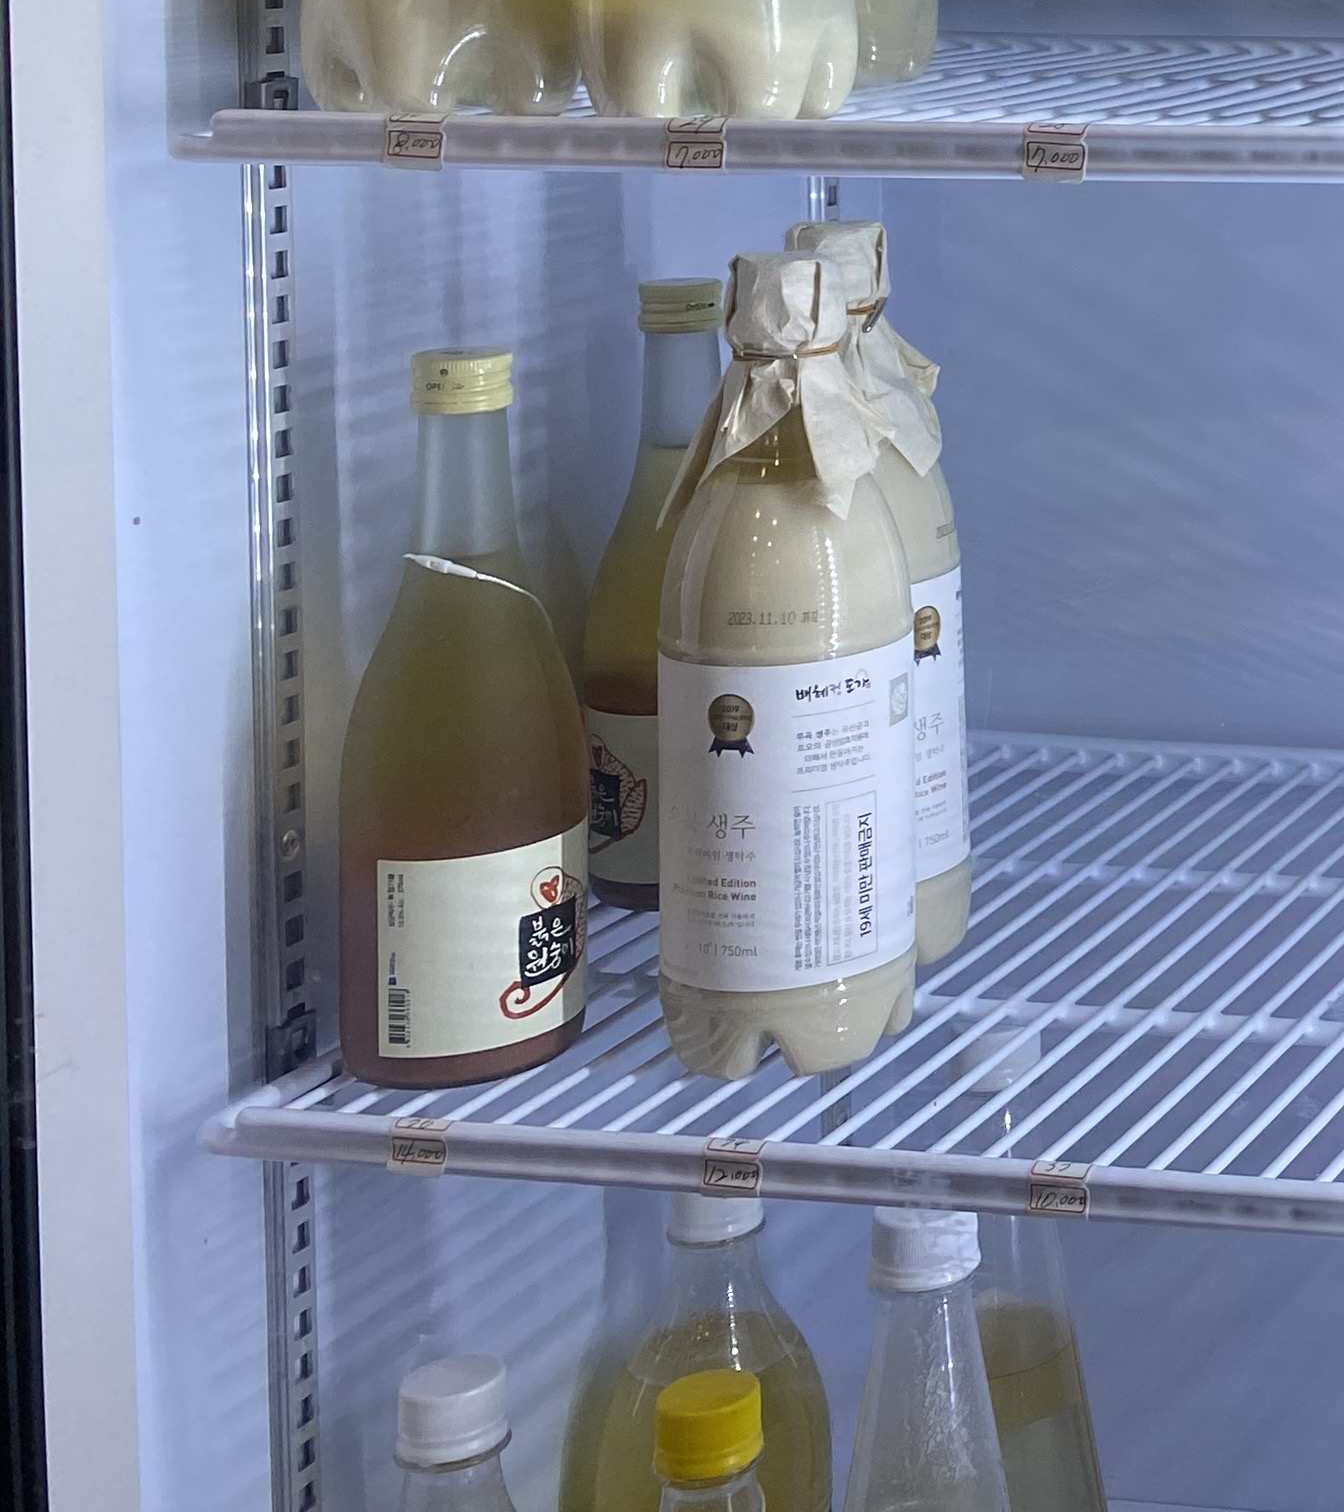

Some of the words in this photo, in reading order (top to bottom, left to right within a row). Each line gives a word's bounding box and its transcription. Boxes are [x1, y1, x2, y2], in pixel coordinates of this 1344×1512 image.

[707, 813, 757, 840] 생주
[857, 812, 873, 871] 판매금지
[708, 890, 728, 901] Rice
[731, 891, 757, 902] Wine
[721, 878, 757, 889] Edition
[858, 874, 873, 904] 미만
[859, 905, 874, 938] 19세
[722, 945, 759, 958] 750ml
